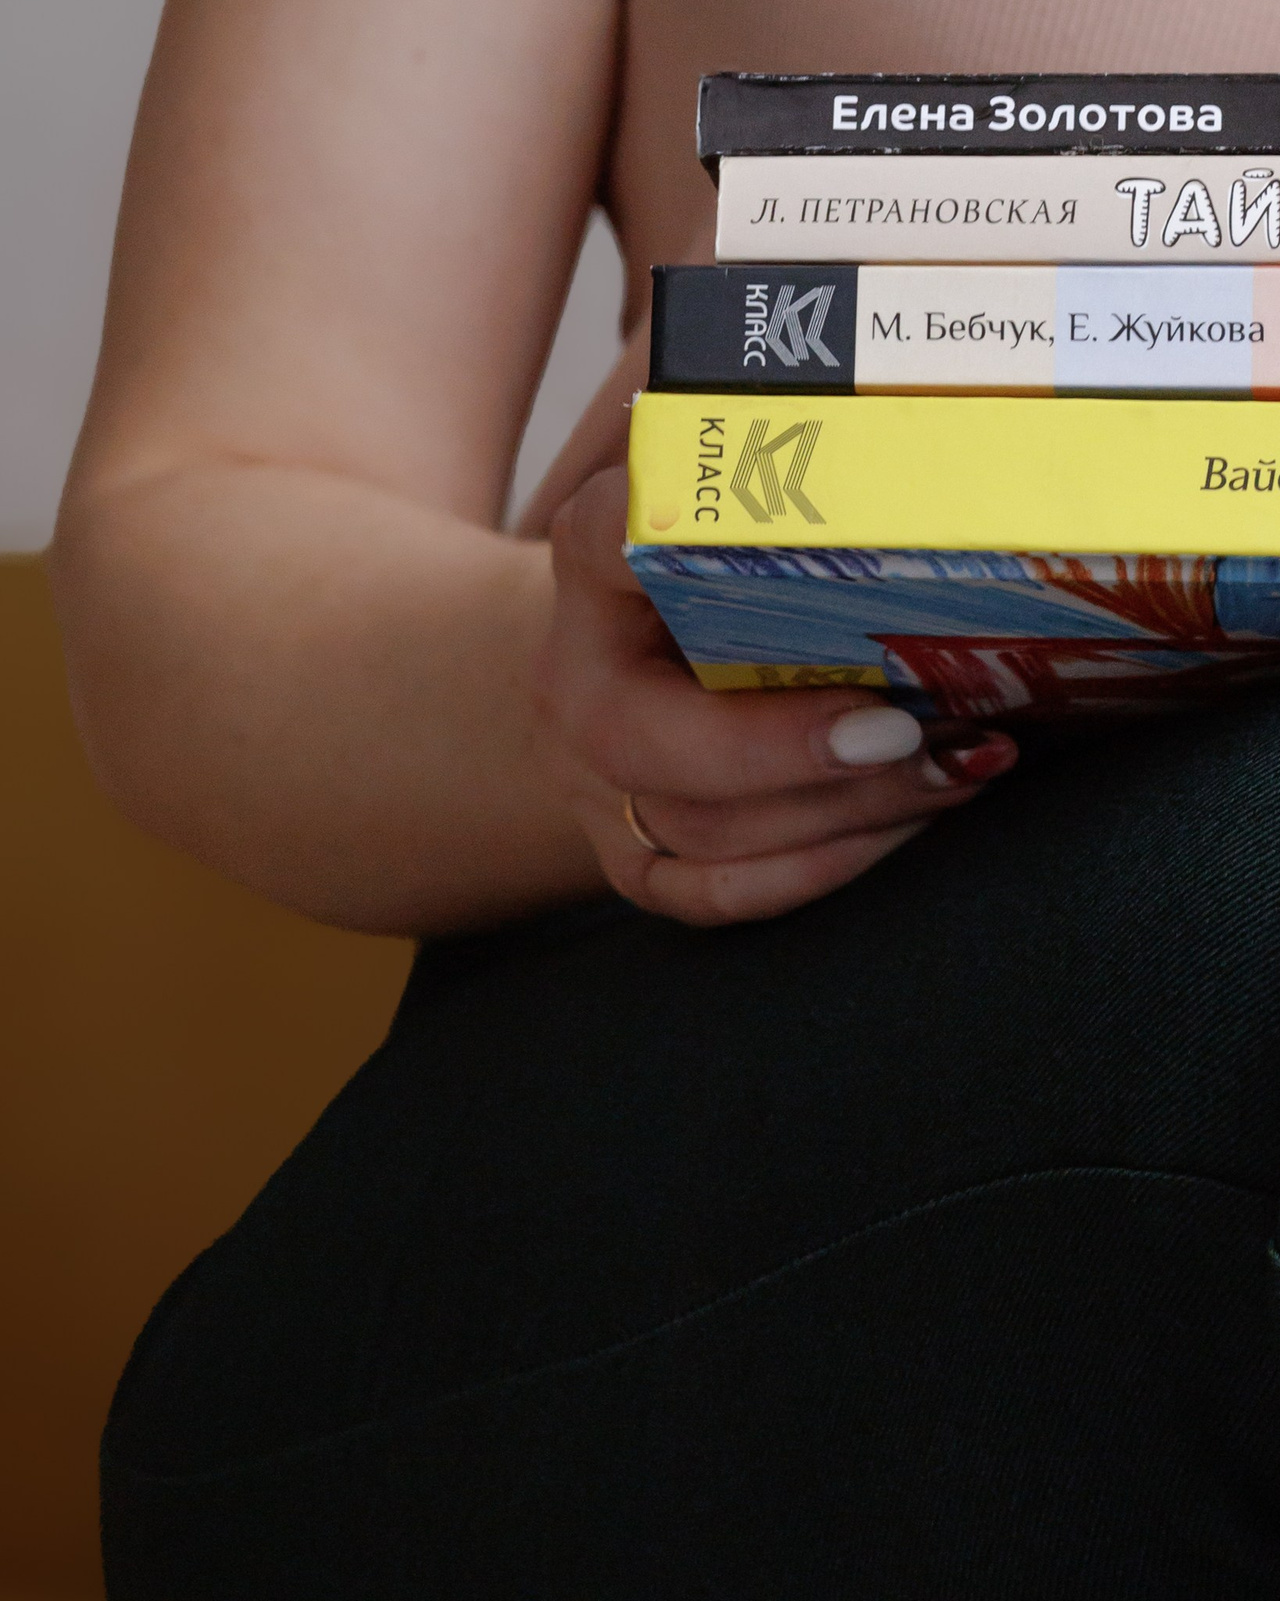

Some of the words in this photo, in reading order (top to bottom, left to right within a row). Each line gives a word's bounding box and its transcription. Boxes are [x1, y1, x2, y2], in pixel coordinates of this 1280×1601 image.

[832, 95, 975, 132] Елена
[988, 95, 1223, 133] Золотова
[751, 198, 785, 225] Л.
[799, 198, 1078, 225] ПЕТРАНОВСКАЯ
[743, 284, 769, 367] КЛАСС
[871, 312, 911, 342] М.
[925, 311, 1055, 350] Бебчук,
[1068, 313, 1099, 343] Е.
[1109, 312, 1266, 349] Жуйкова
[694, 417, 725, 523] КЛАСС
